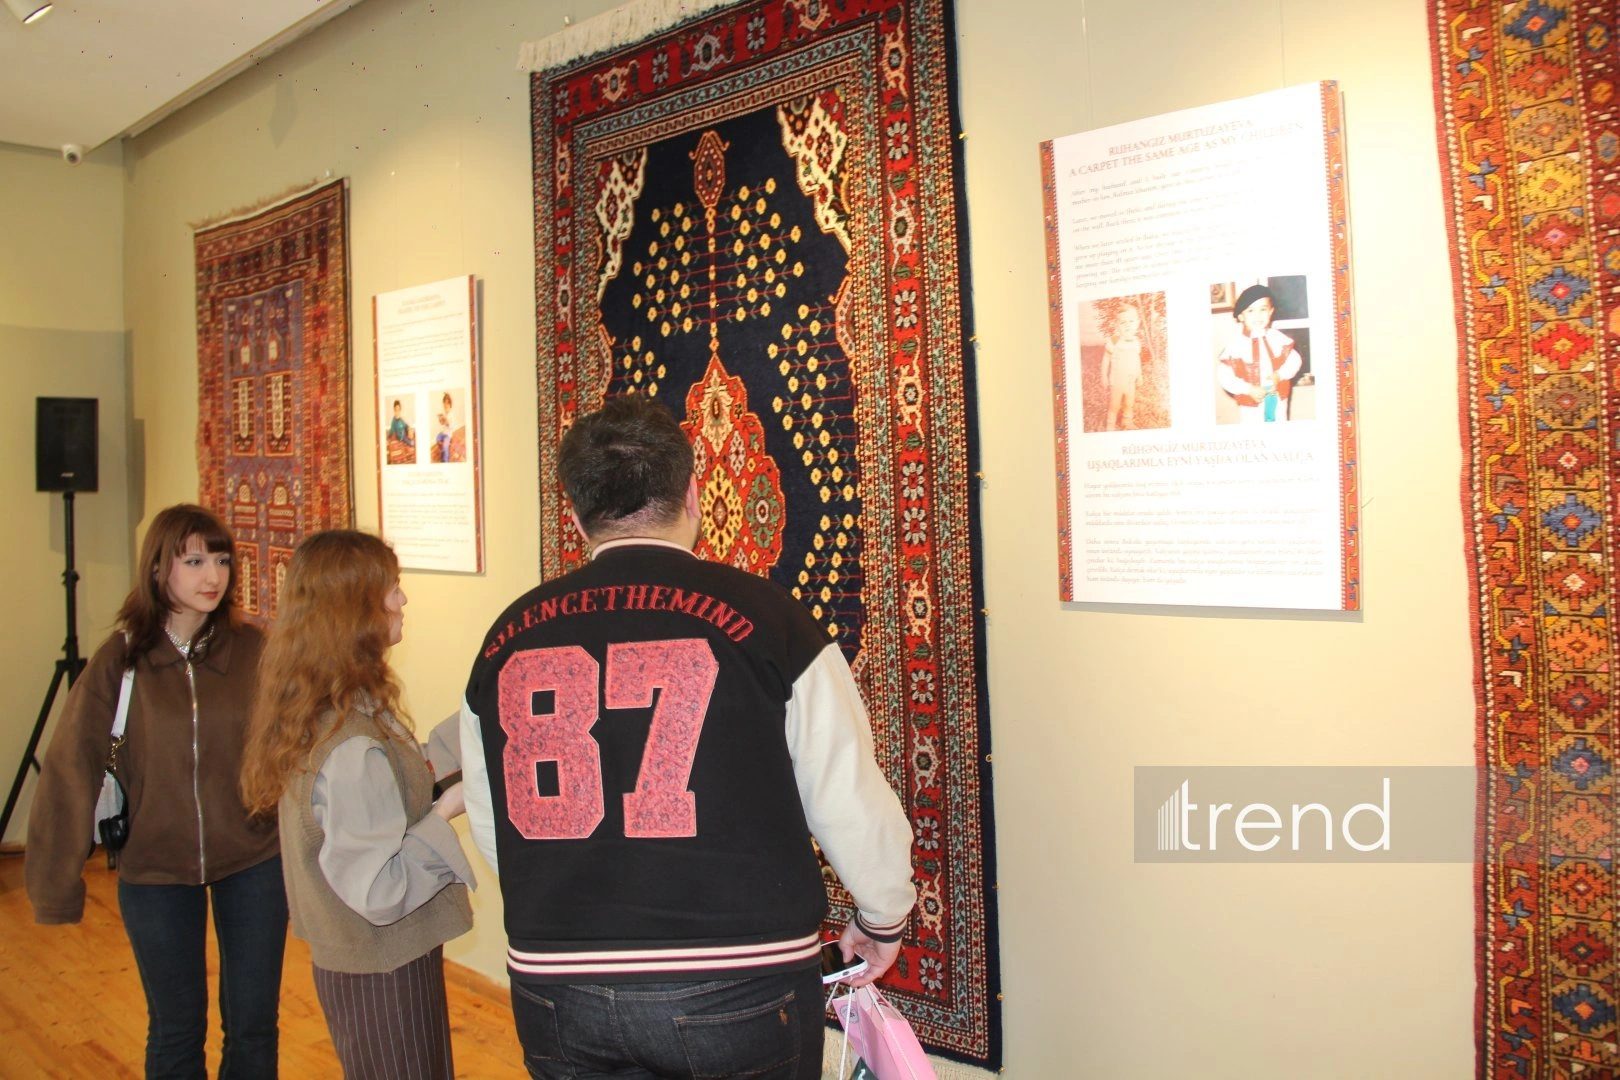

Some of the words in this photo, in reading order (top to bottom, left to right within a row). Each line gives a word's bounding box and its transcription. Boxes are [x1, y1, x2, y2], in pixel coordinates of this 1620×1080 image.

[1068, 168, 1077, 177] A
[1078, 158, 1118, 175] CARPET
[1122, 153, 1144, 166] THE
[1145, 147, 1176, 162] SAME
[1178, 142, 1201, 155] AGE
[1205, 139, 1218, 149] AS
[1220, 134, 1237, 146] MY
[498, 638, 719, 840] 87
